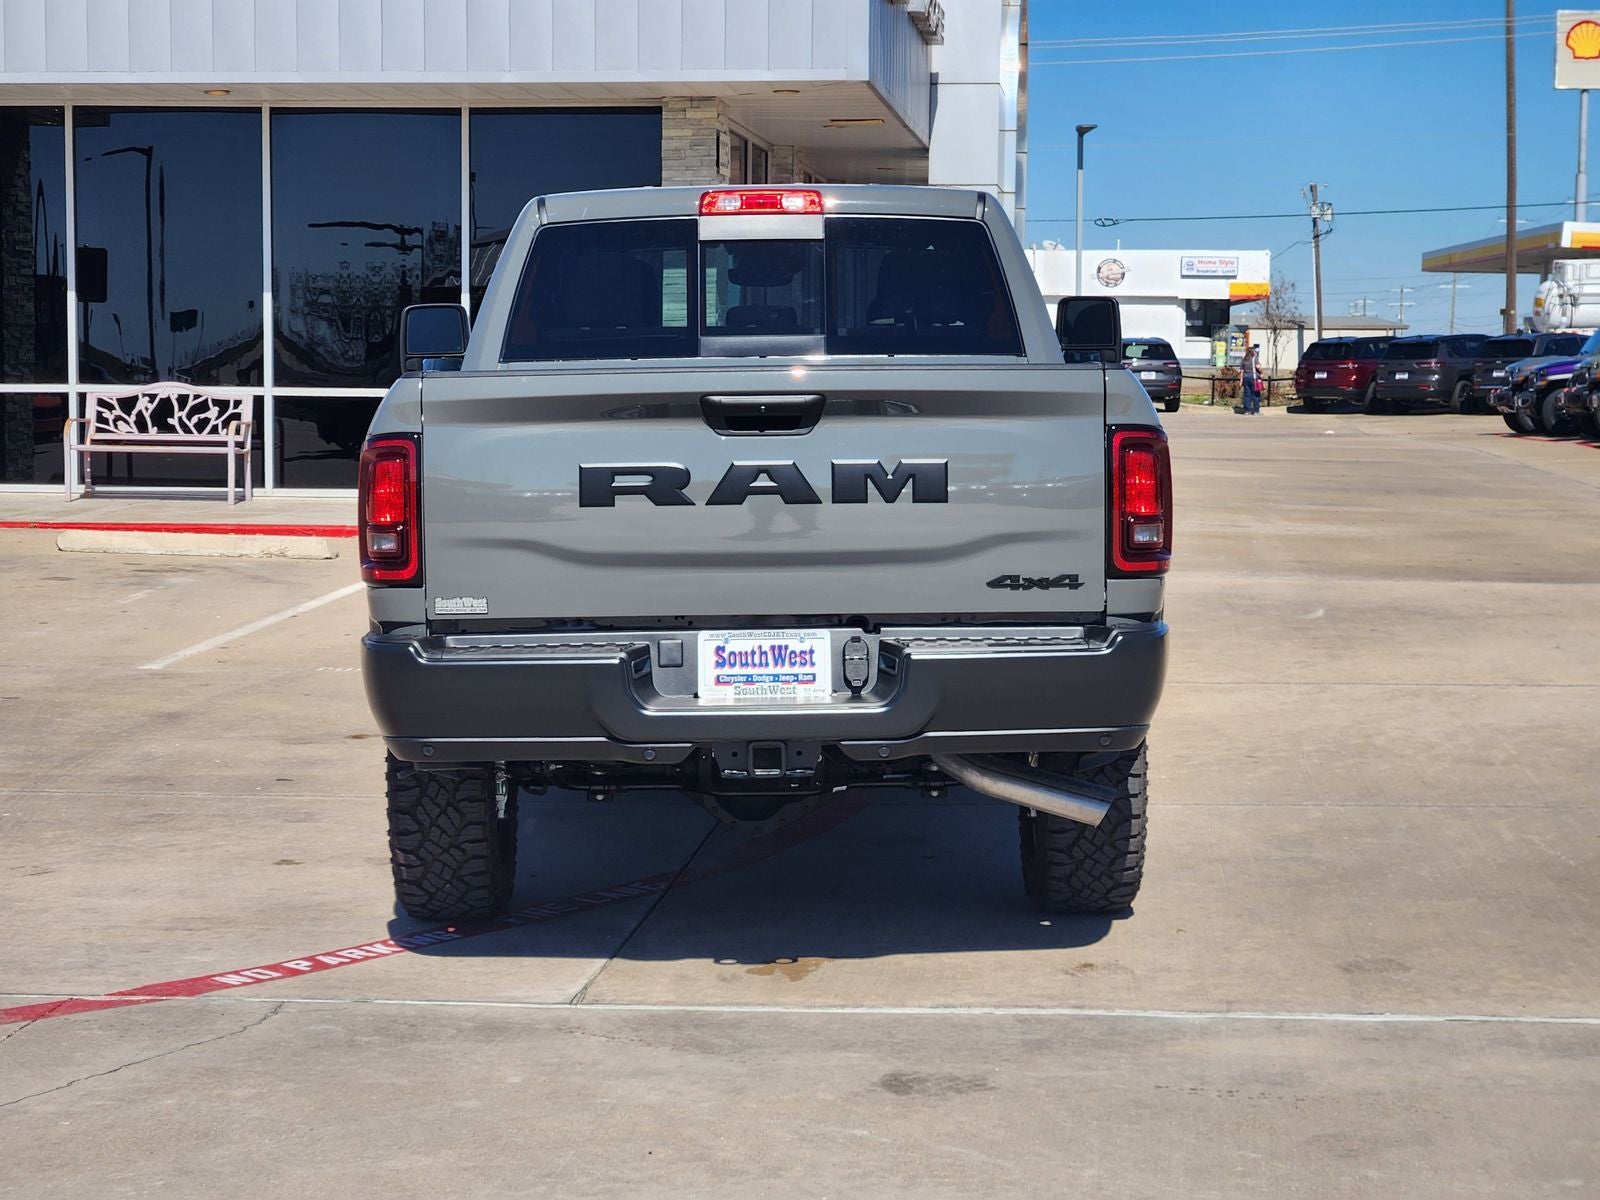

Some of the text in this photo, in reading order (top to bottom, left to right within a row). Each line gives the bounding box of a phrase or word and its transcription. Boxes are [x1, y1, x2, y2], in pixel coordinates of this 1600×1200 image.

[1218, 259, 1235, 267] Style
[579, 457, 949, 508] RAM
[985, 573, 1086, 591] 4x4
[434, 596, 488, 608] SouthWest
[714, 644, 816, 669] SouthWest
[719, 674, 747, 683] Chrysler
[752, 674, 774, 683] Dodge
[778, 674, 795, 683] Jeep
[735, 685, 797, 695] SouthWest
[210, 967, 283, 985] NO
[280, 929, 462, 971] PARKING
